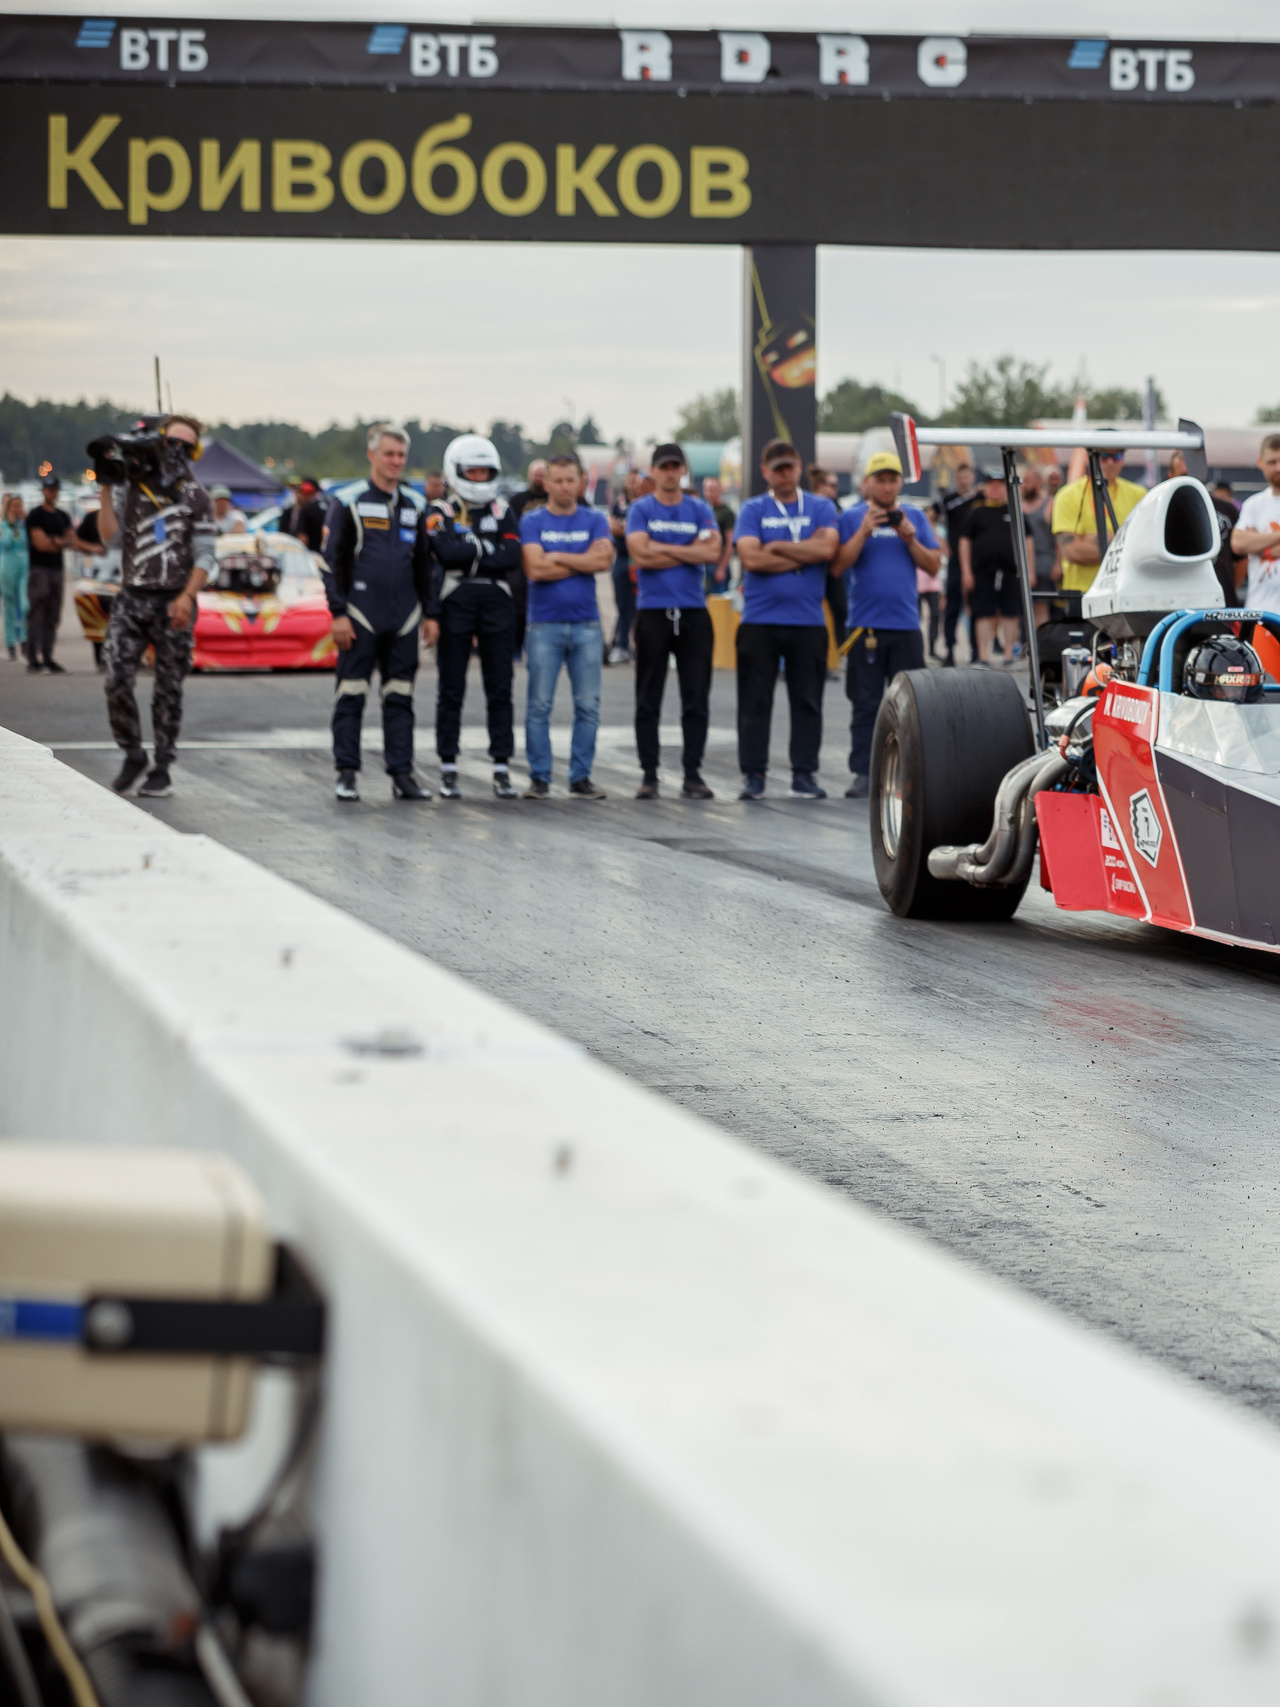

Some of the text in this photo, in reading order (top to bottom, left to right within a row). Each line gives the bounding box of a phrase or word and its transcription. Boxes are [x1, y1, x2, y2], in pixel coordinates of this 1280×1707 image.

[120, 29, 208, 72] ВТБ
[410, 34, 499, 78] ВТБ
[1109, 48, 1195, 92] ВТБ
[48, 113, 752, 225] Кривобоков
